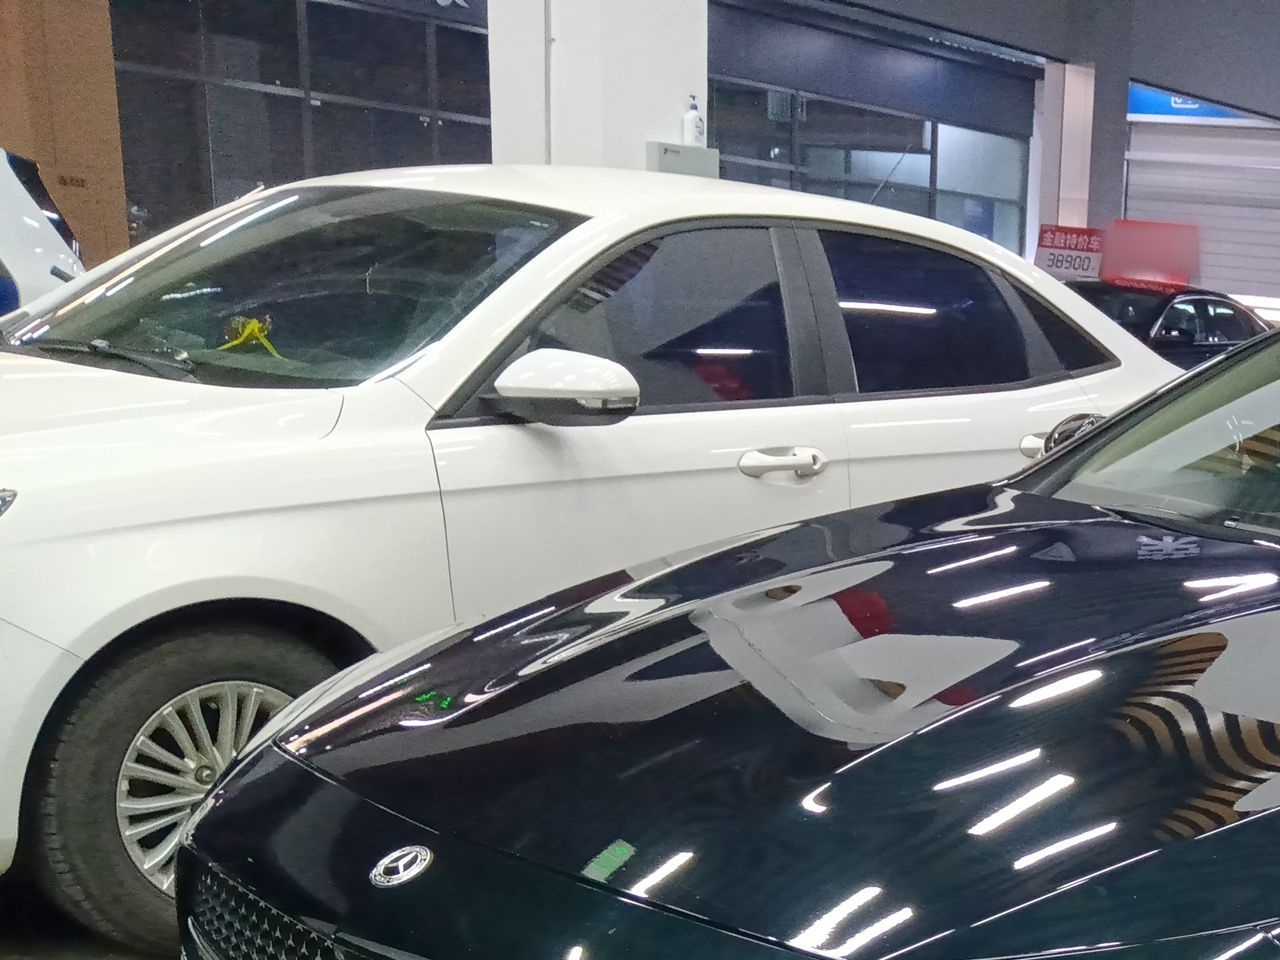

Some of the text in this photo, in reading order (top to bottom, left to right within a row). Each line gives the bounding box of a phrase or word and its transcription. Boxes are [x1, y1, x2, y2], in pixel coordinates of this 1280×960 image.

[1042, 230, 1102, 251] 金融特价车
[1047, 252, 1091, 271] 38900
